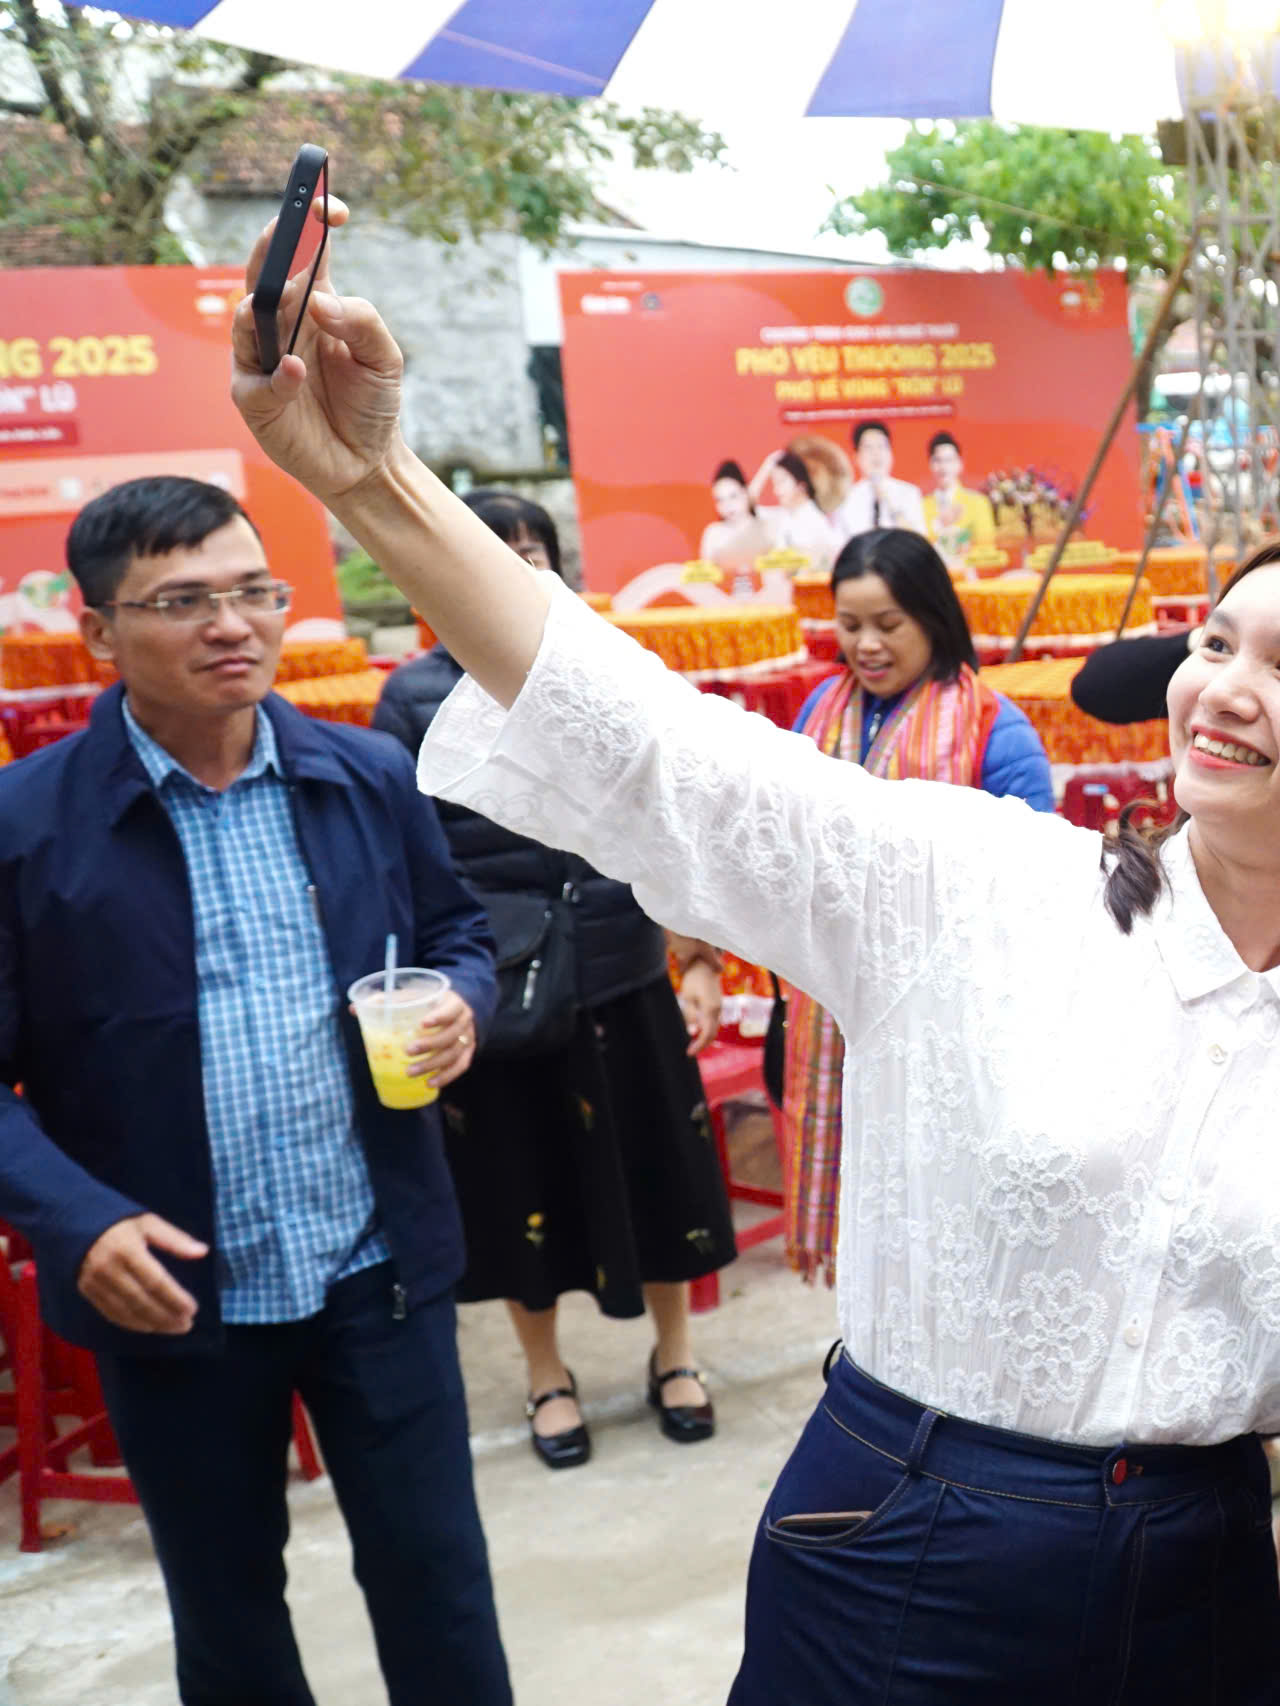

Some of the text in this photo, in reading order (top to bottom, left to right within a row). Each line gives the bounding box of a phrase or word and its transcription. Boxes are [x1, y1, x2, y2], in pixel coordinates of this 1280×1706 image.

[49, 333, 158, 378] 2025
[791, 341, 840, 374] YÊU
[938, 342, 996, 370] 2025
